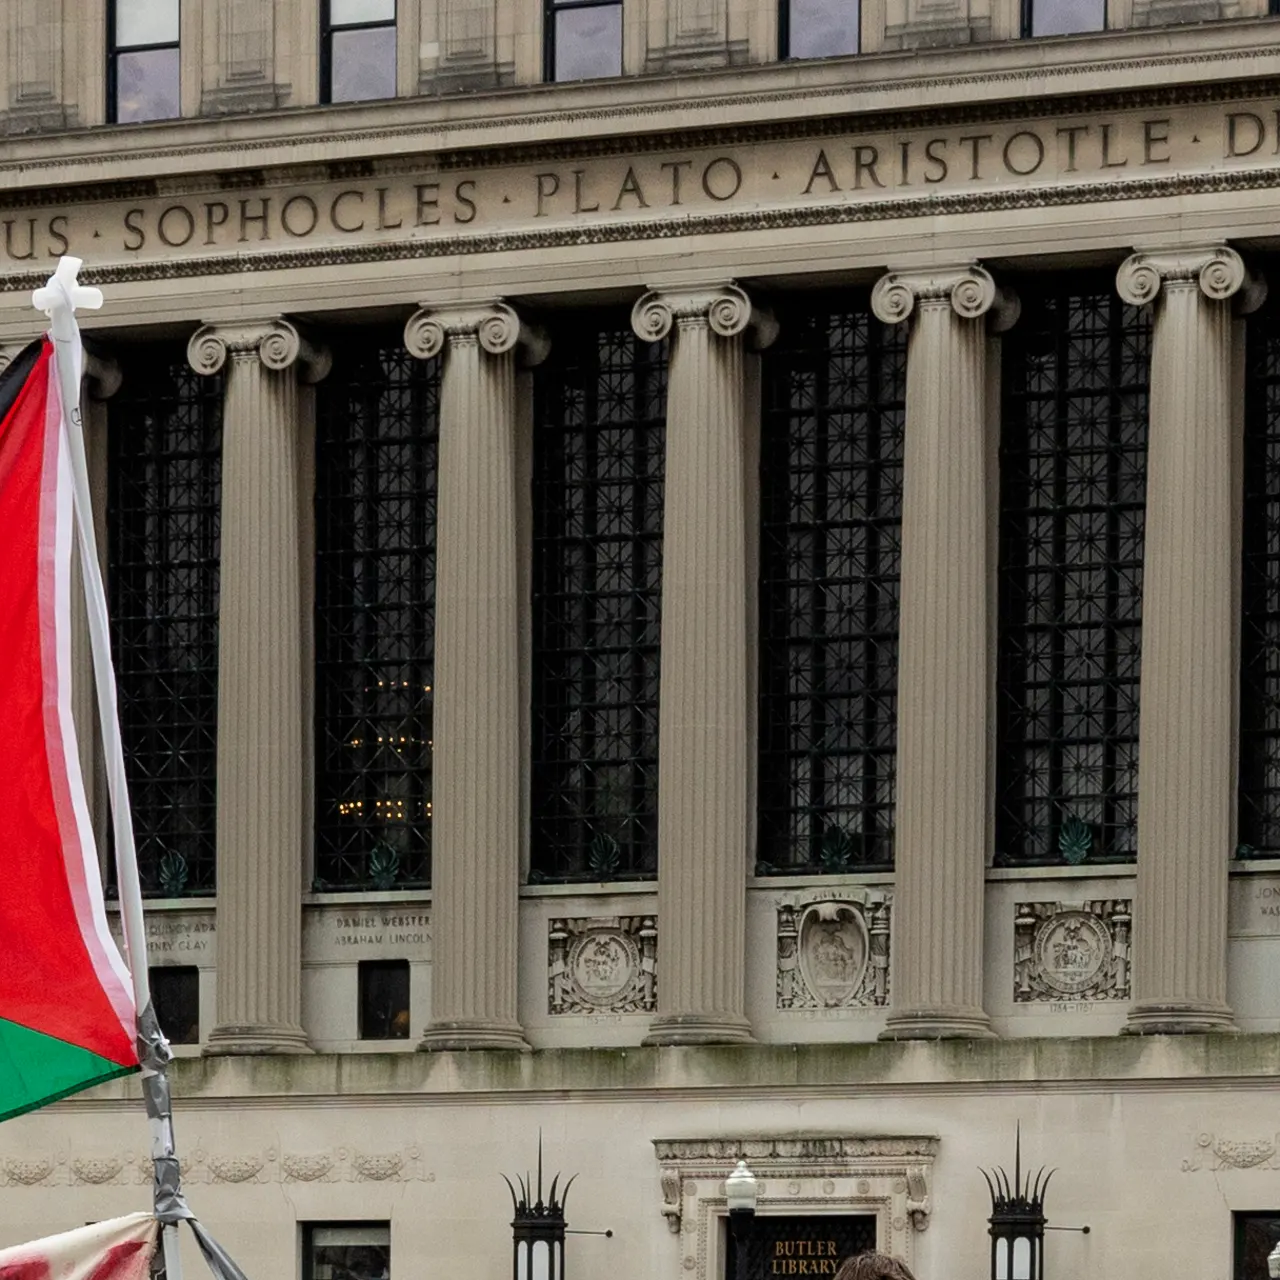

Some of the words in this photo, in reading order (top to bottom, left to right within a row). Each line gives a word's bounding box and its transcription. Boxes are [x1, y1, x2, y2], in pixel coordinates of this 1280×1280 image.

[123, 180, 479, 252] SOPHOCLES
[533, 157, 743, 218] PLATO
[801, 118, 1172, 195] ARISTOTLE
[381, 915, 431, 927] WEBSTER
[775, 1241, 837, 1256] BUTLER
[771, 1260, 839, 1275] LIBRARY
